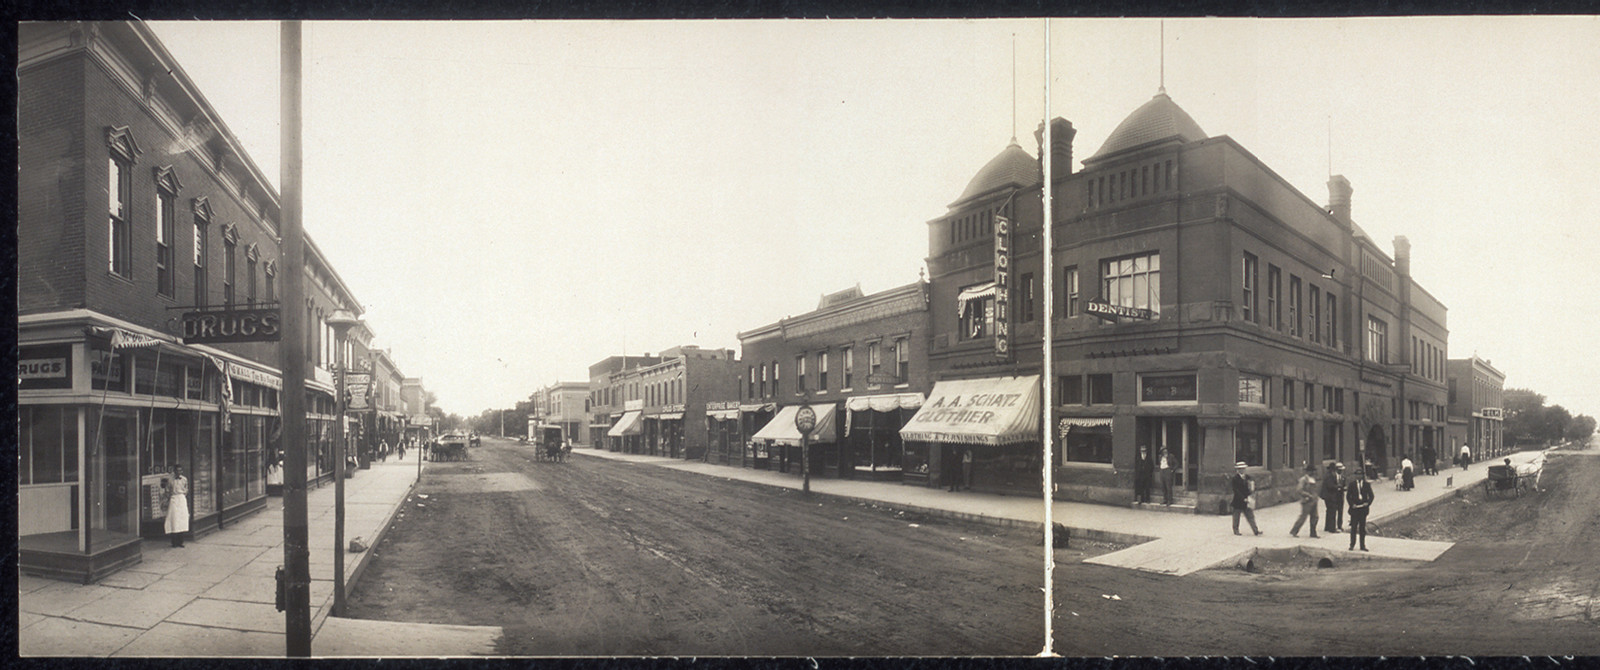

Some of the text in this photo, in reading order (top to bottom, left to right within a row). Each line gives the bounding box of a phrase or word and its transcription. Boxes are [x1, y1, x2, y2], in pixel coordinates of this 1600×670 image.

[999, 220, 1008, 353] CLOTHING
[183, 313, 279, 338] DRUGS
[18, 361, 62, 375] RUGS
[932, 393, 1022, 408] A. A. SCHATZ
[916, 410, 995, 424] CLOTHIER
